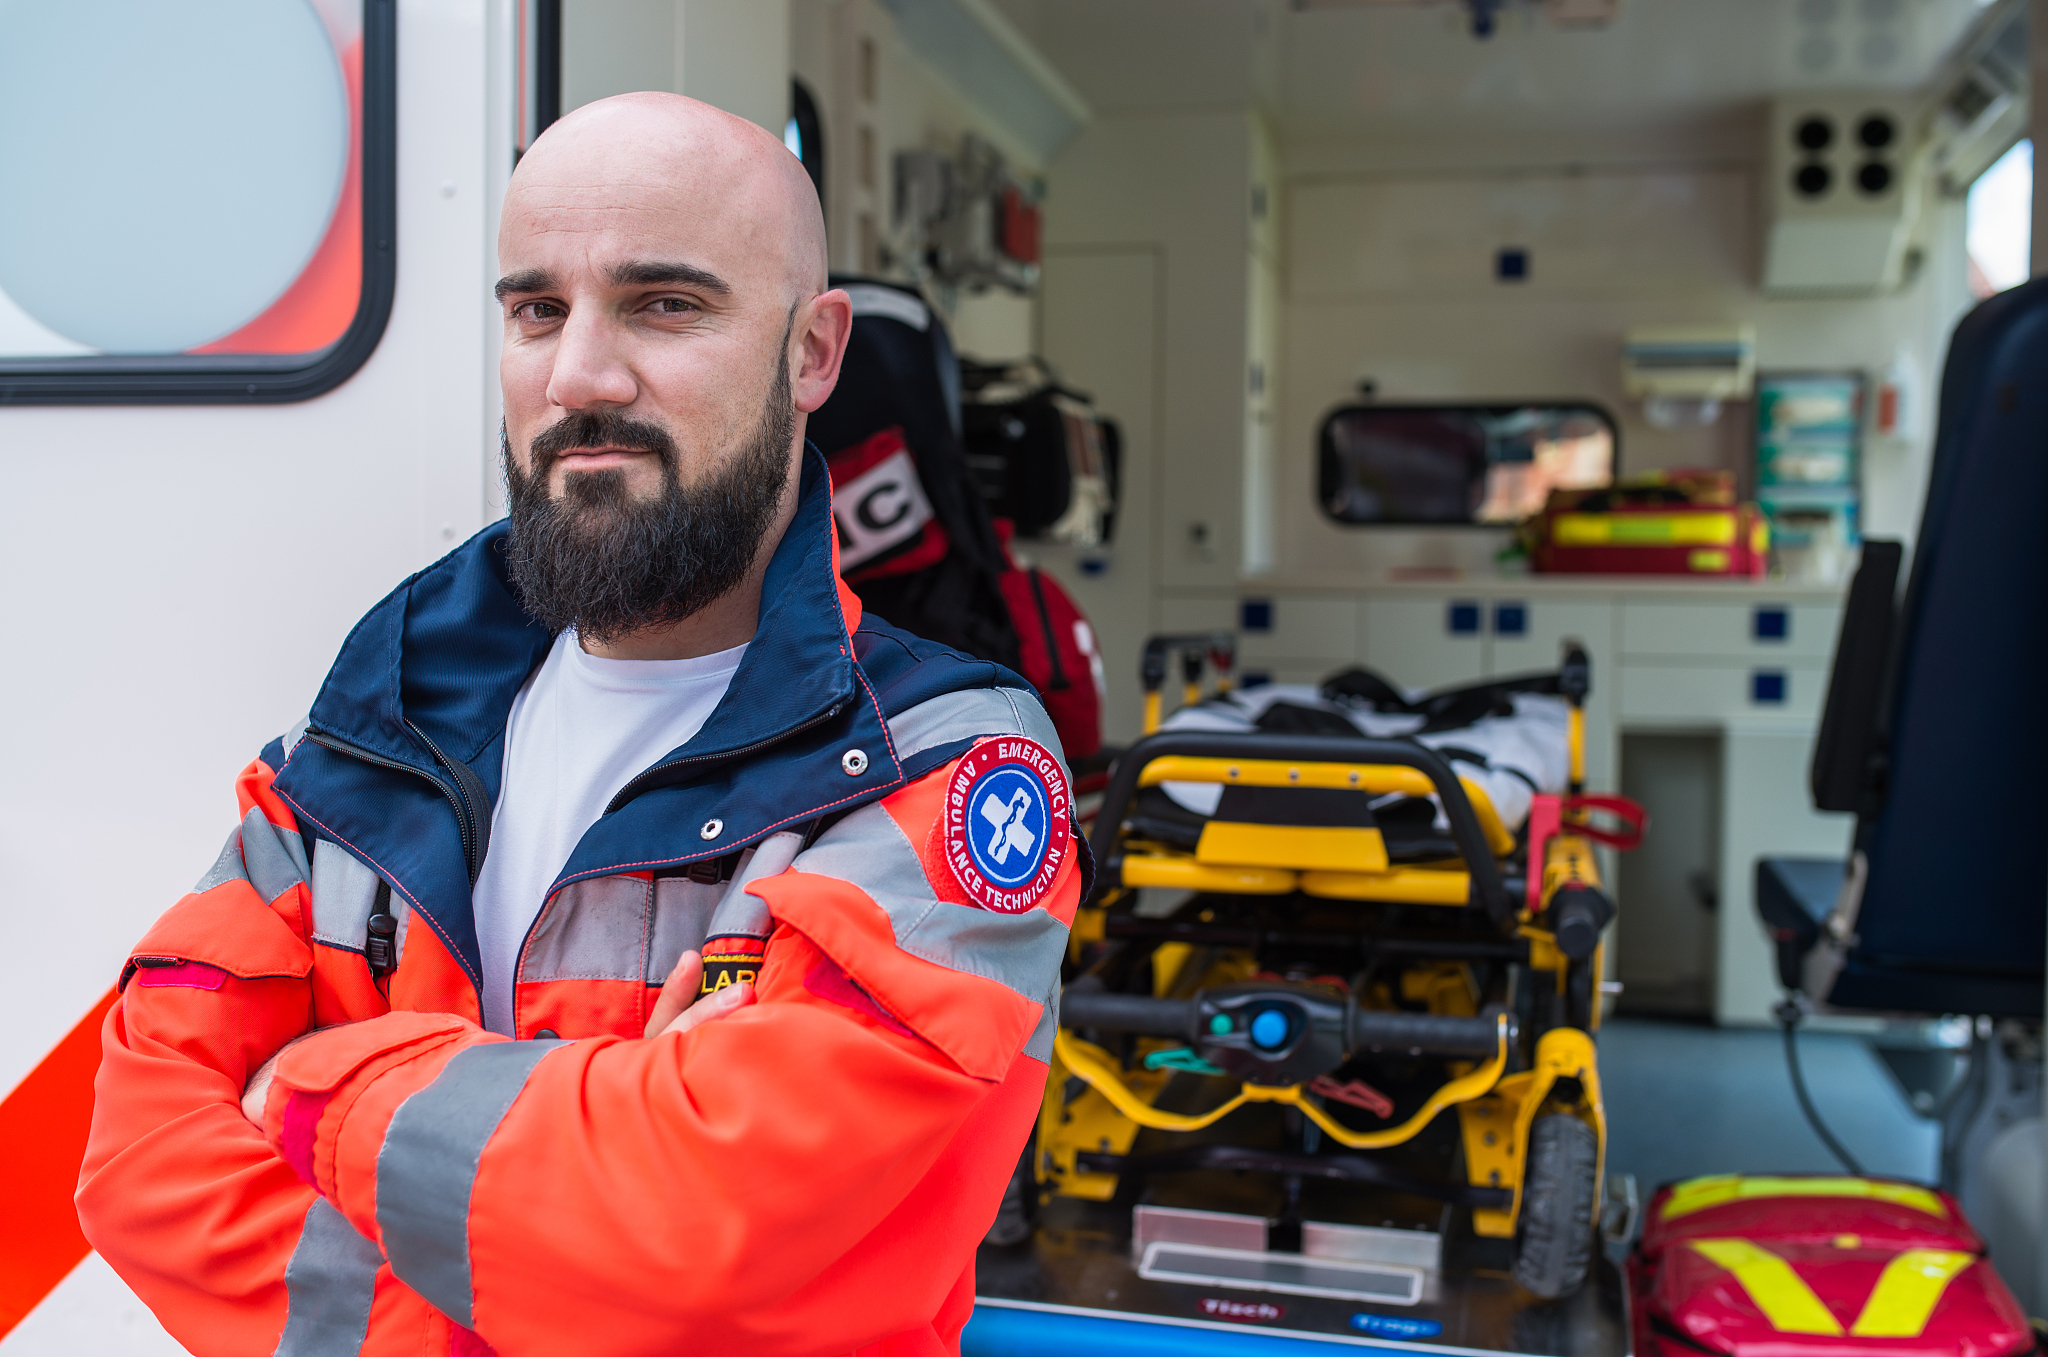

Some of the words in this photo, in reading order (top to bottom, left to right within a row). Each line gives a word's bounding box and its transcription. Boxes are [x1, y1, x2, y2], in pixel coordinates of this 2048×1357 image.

[998, 743, 1065, 820] EMERGENCY
[950, 760, 983, 893] AMBULANCE
[986, 847, 1061, 911] TECHNICIAN
[701, 969, 761, 994] LAR
